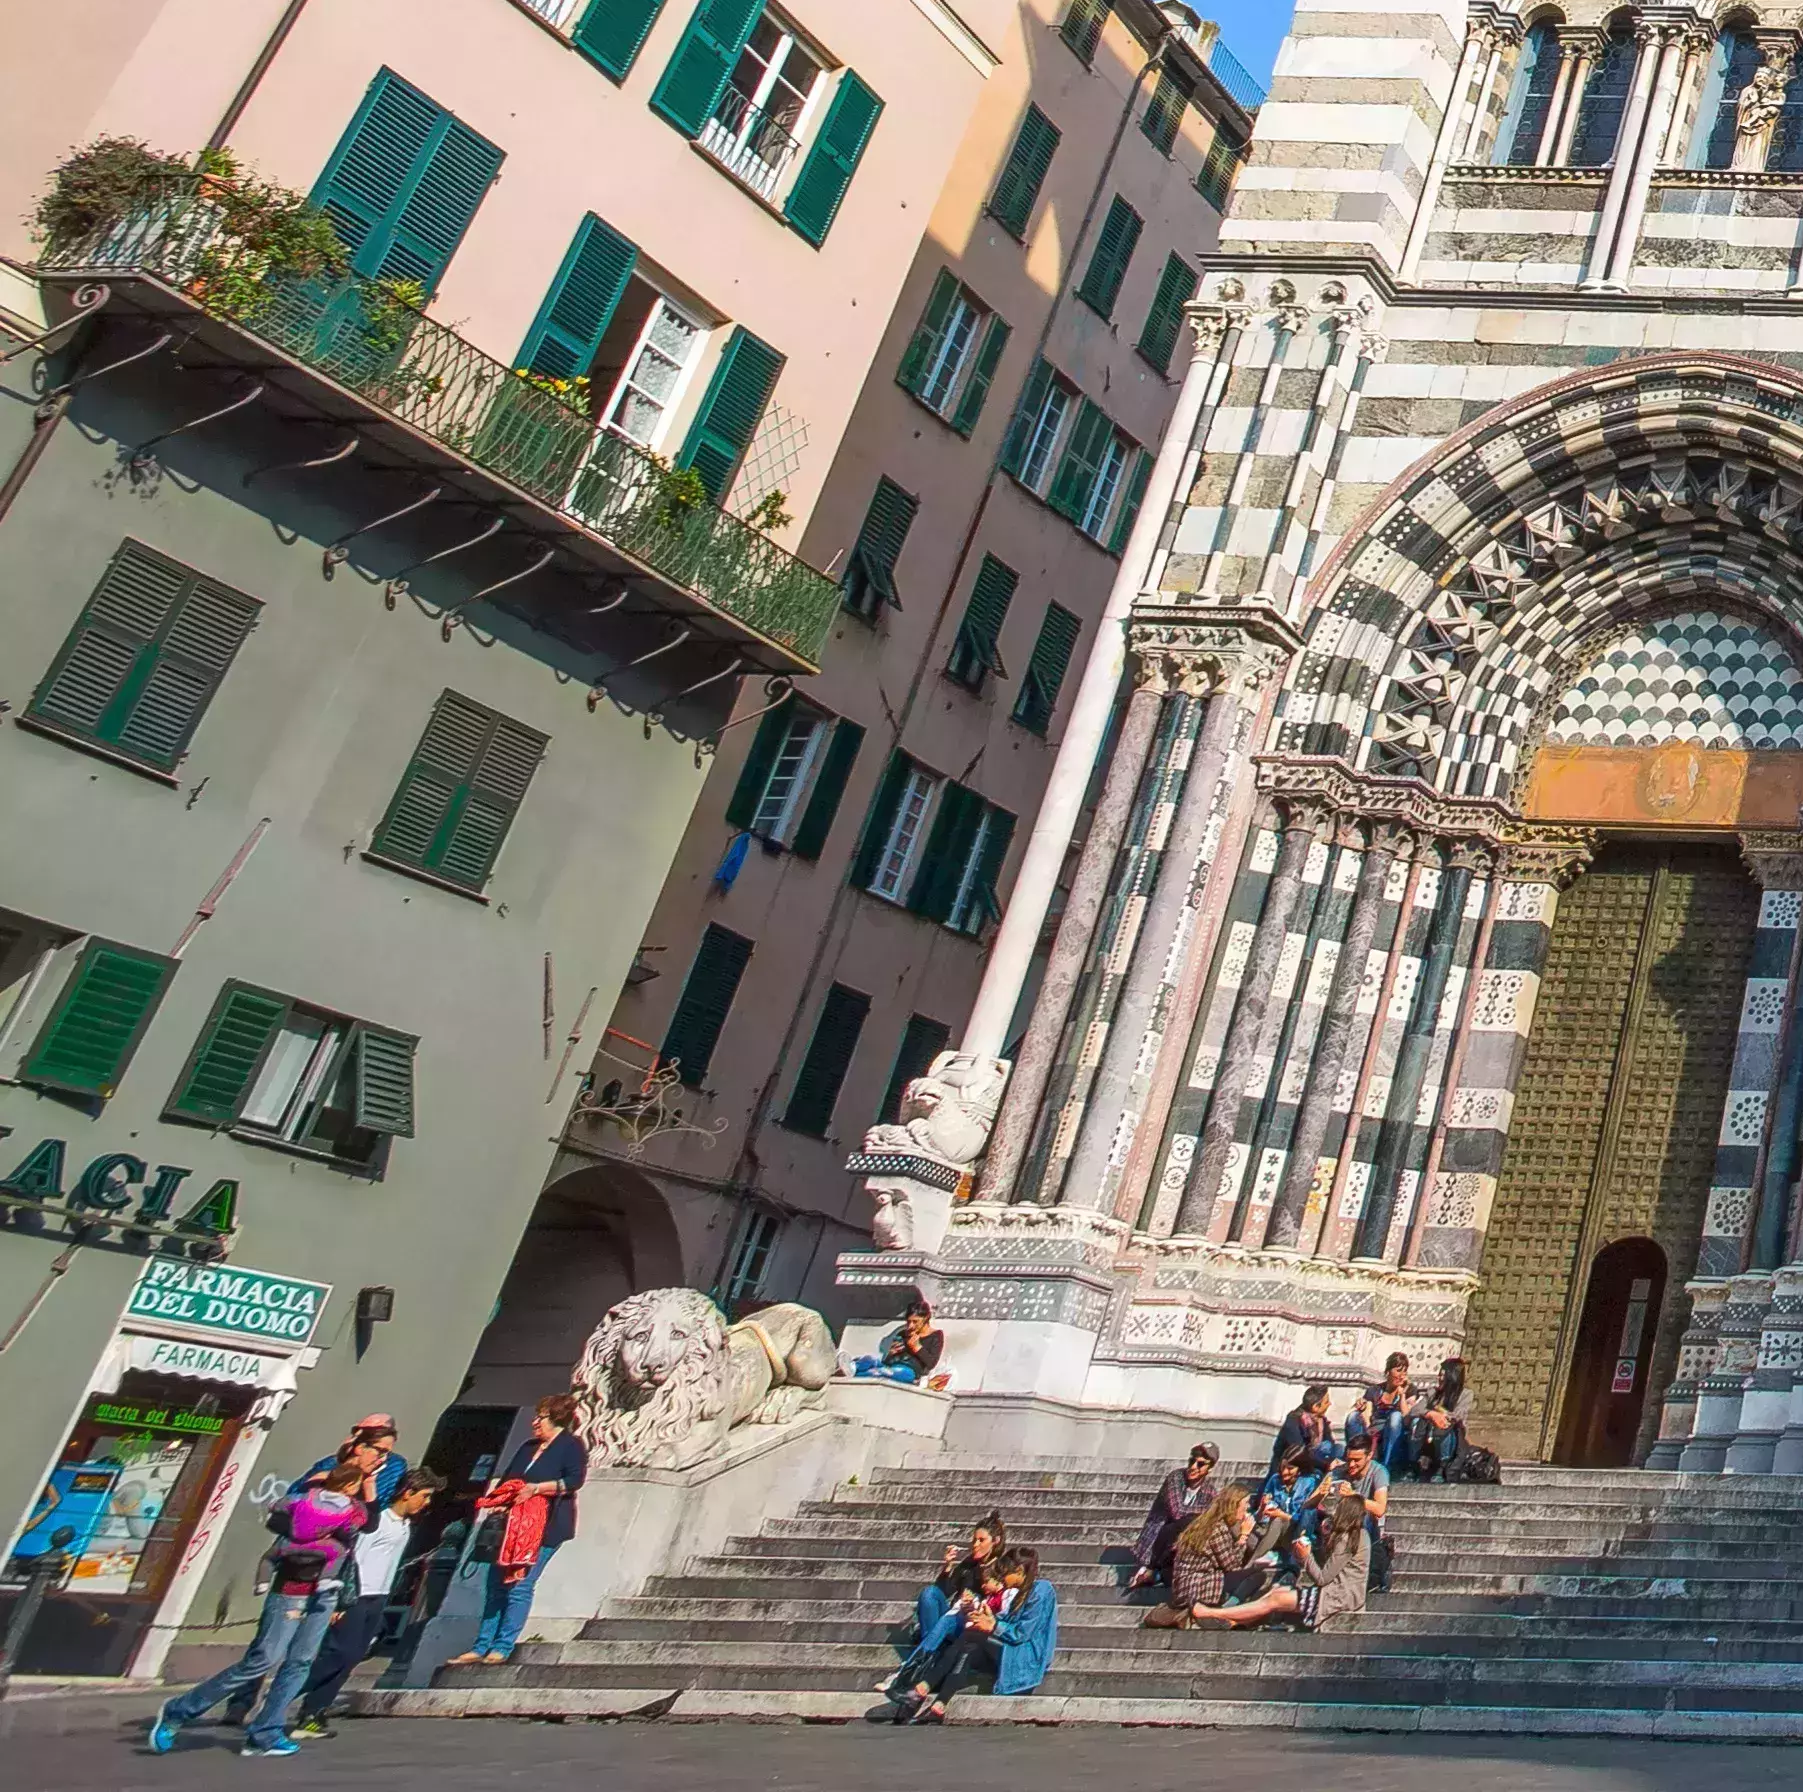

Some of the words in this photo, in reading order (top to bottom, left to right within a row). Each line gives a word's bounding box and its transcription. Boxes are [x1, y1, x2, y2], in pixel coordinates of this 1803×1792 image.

[0, 1126, 240, 1234] ACIA
[133, 1287, 199, 1318] DEL
[202, 1299, 311, 1337] DUOMO
[145, 1261, 316, 1315] FARMACIA
[151, 1343, 261, 1377] FARMACIA
